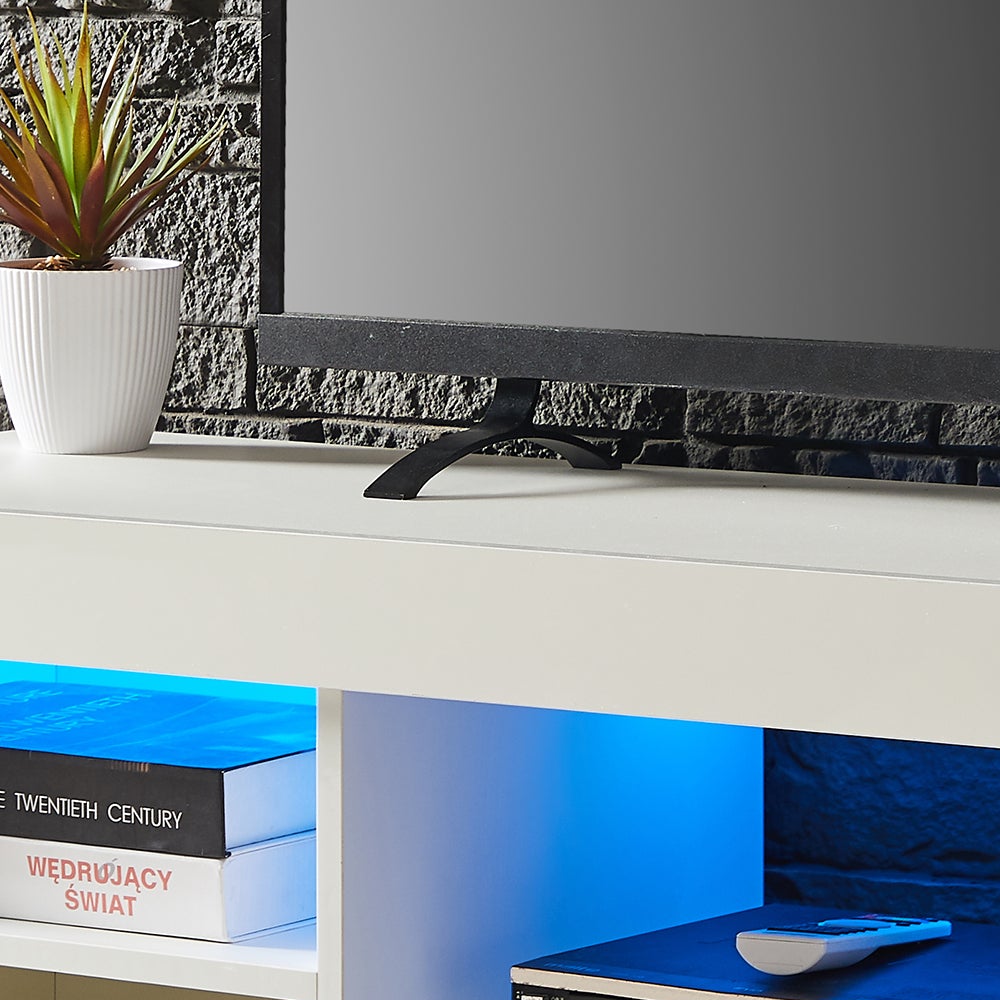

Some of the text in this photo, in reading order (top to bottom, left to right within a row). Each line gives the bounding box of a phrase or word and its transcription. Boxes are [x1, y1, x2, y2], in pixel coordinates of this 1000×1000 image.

[14, 792, 98, 820] TWENTIETH
[107, 803, 183, 830] CENTURY
[26, 855, 173, 893] WĘDRUJĄCY
[64, 883, 137, 917] ŚWIAT
